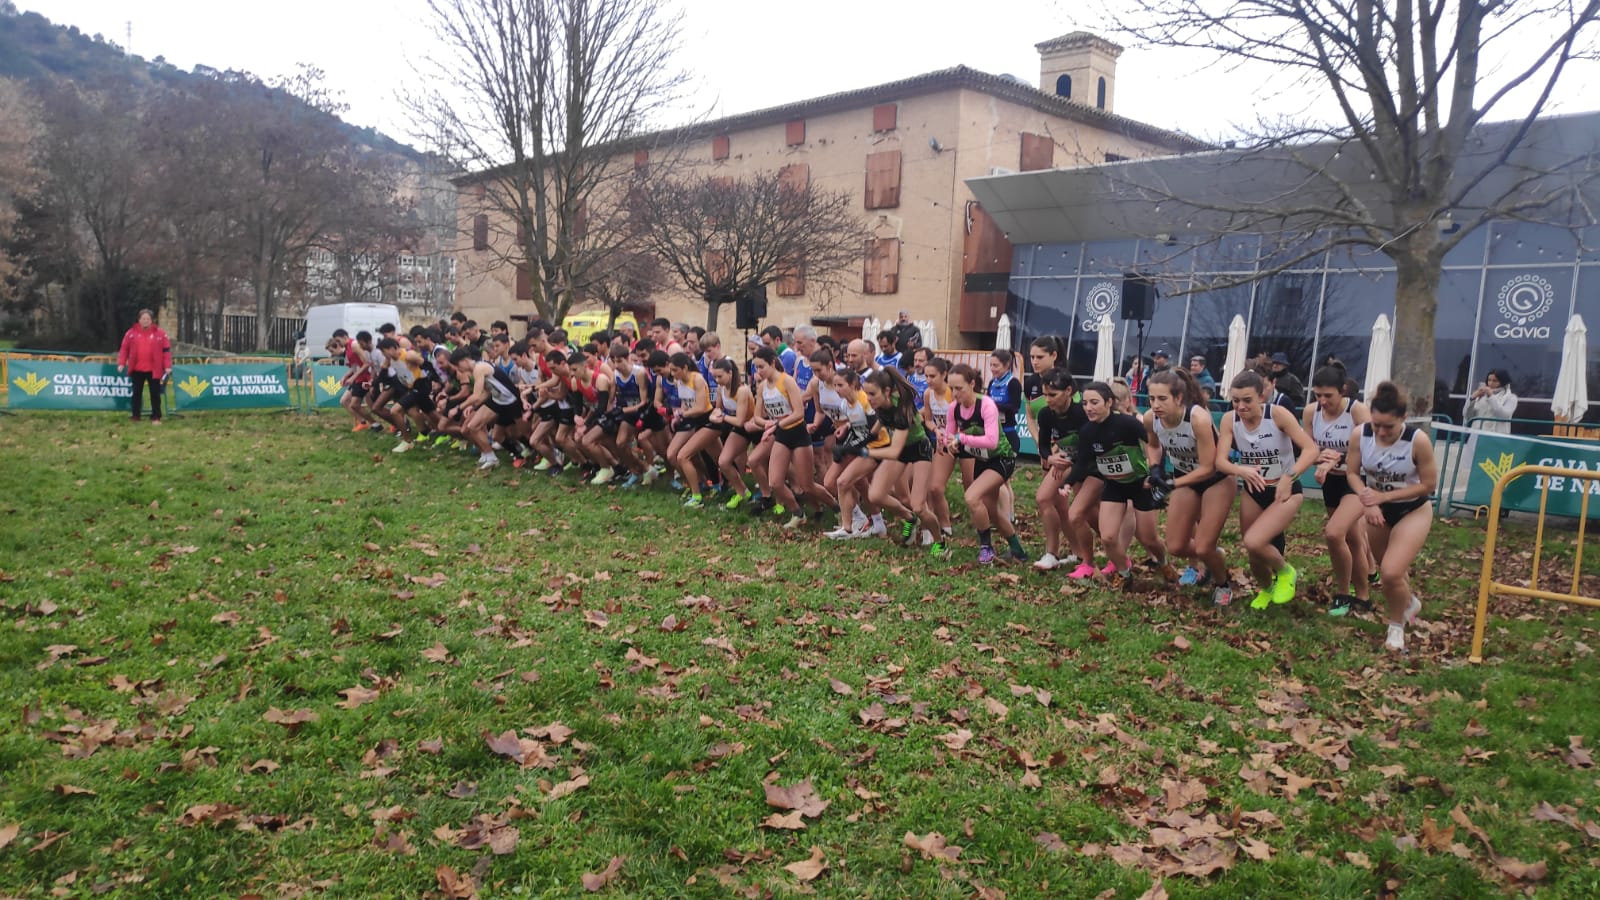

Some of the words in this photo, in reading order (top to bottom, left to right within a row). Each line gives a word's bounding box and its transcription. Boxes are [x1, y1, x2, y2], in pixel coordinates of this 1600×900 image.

[1494, 323, 1550, 338] Gavia
[53, 374, 86, 385] CAJA
[89, 375, 133, 386] RURAL
[212, 375, 240, 385] CAJA
[241, 375, 280, 384] RURAL
[54, 385, 74, 395] DE
[213, 386, 230, 396] DE
[231, 385, 286, 395] NAVARRA
[1107, 463, 1124, 474] 58
[1534, 474, 1566, 492] DE
